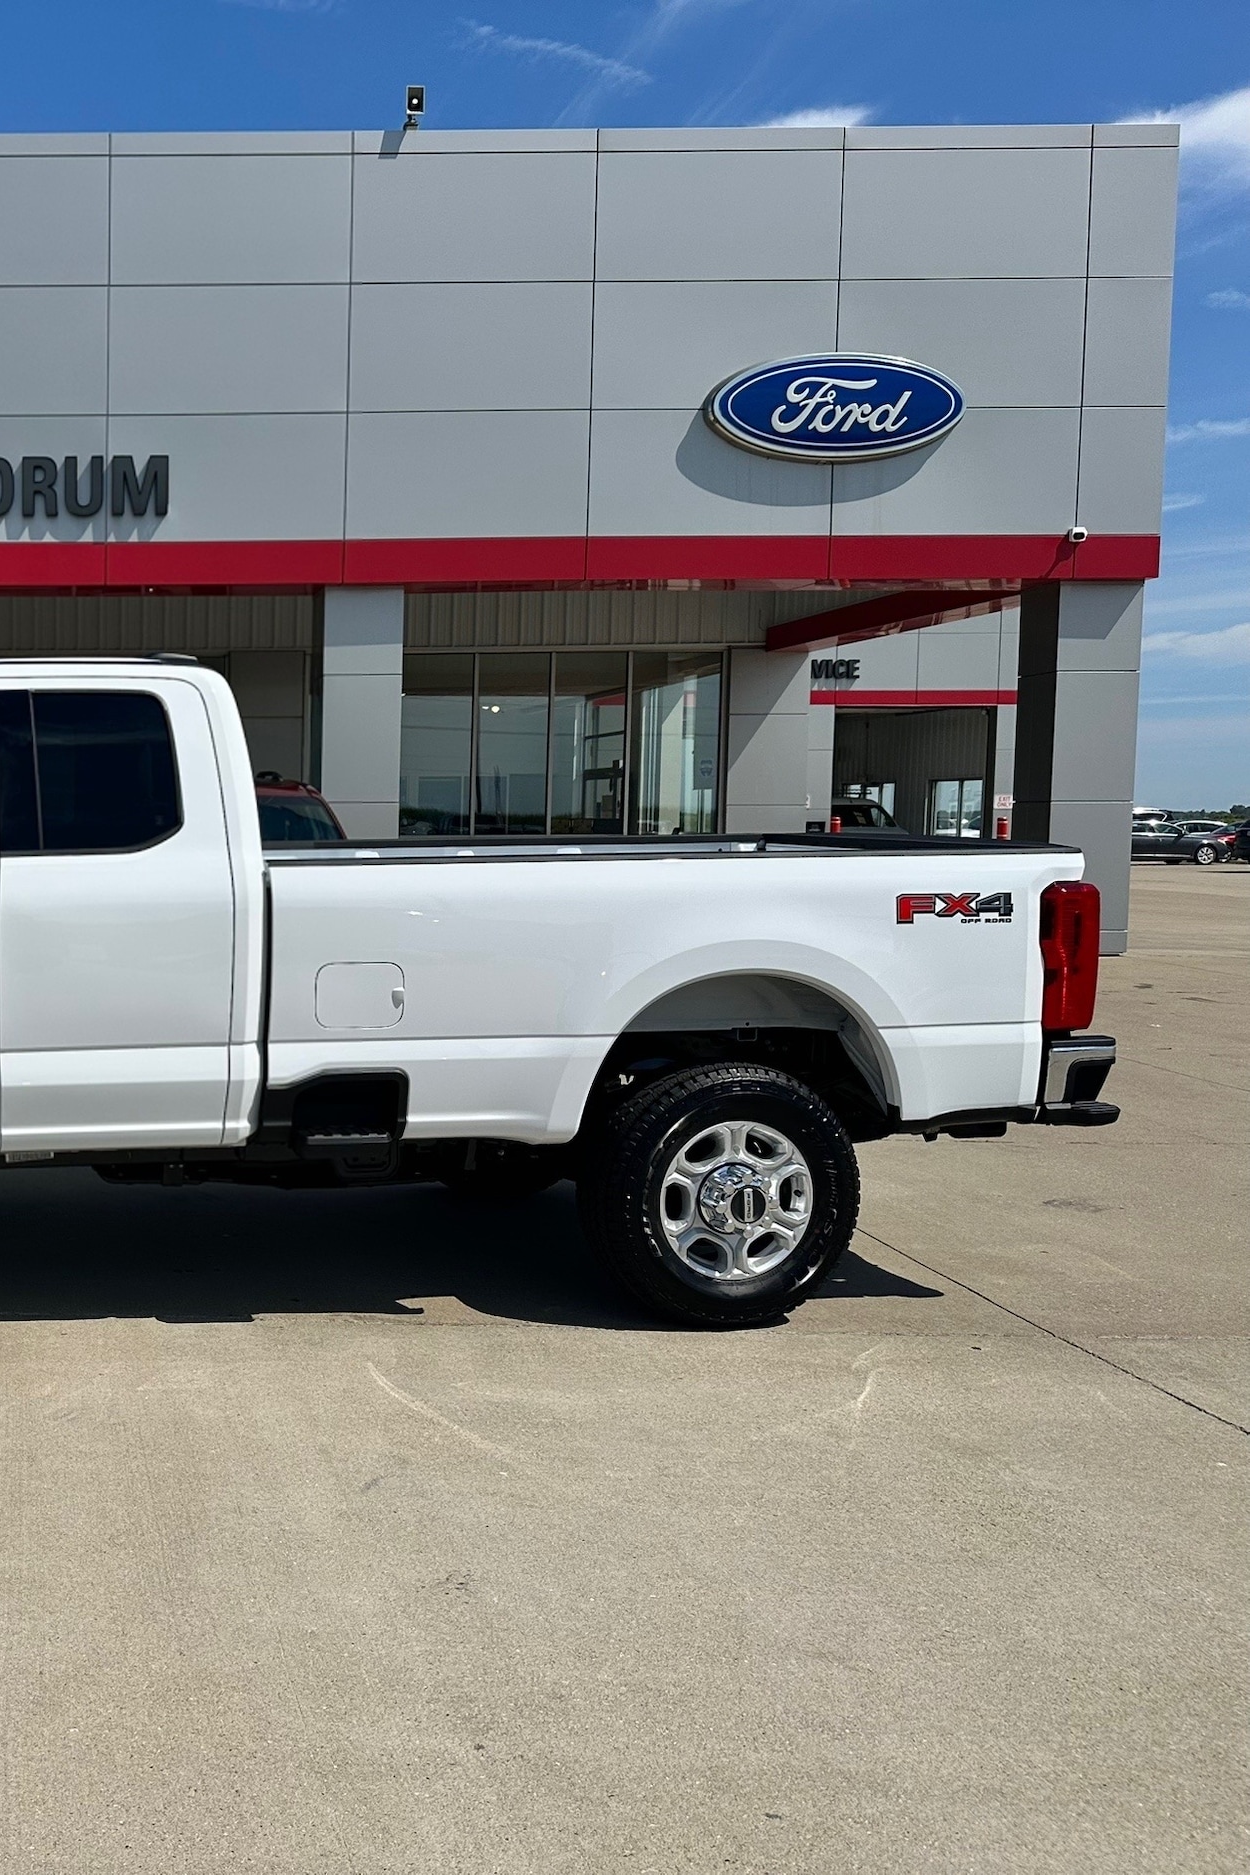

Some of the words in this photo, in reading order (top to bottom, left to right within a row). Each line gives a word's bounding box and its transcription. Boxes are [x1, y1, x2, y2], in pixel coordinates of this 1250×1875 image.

[771, 377, 912, 433] Ford
[810, 659, 861, 679] VICE
[896, 892, 1013, 925] FX4
